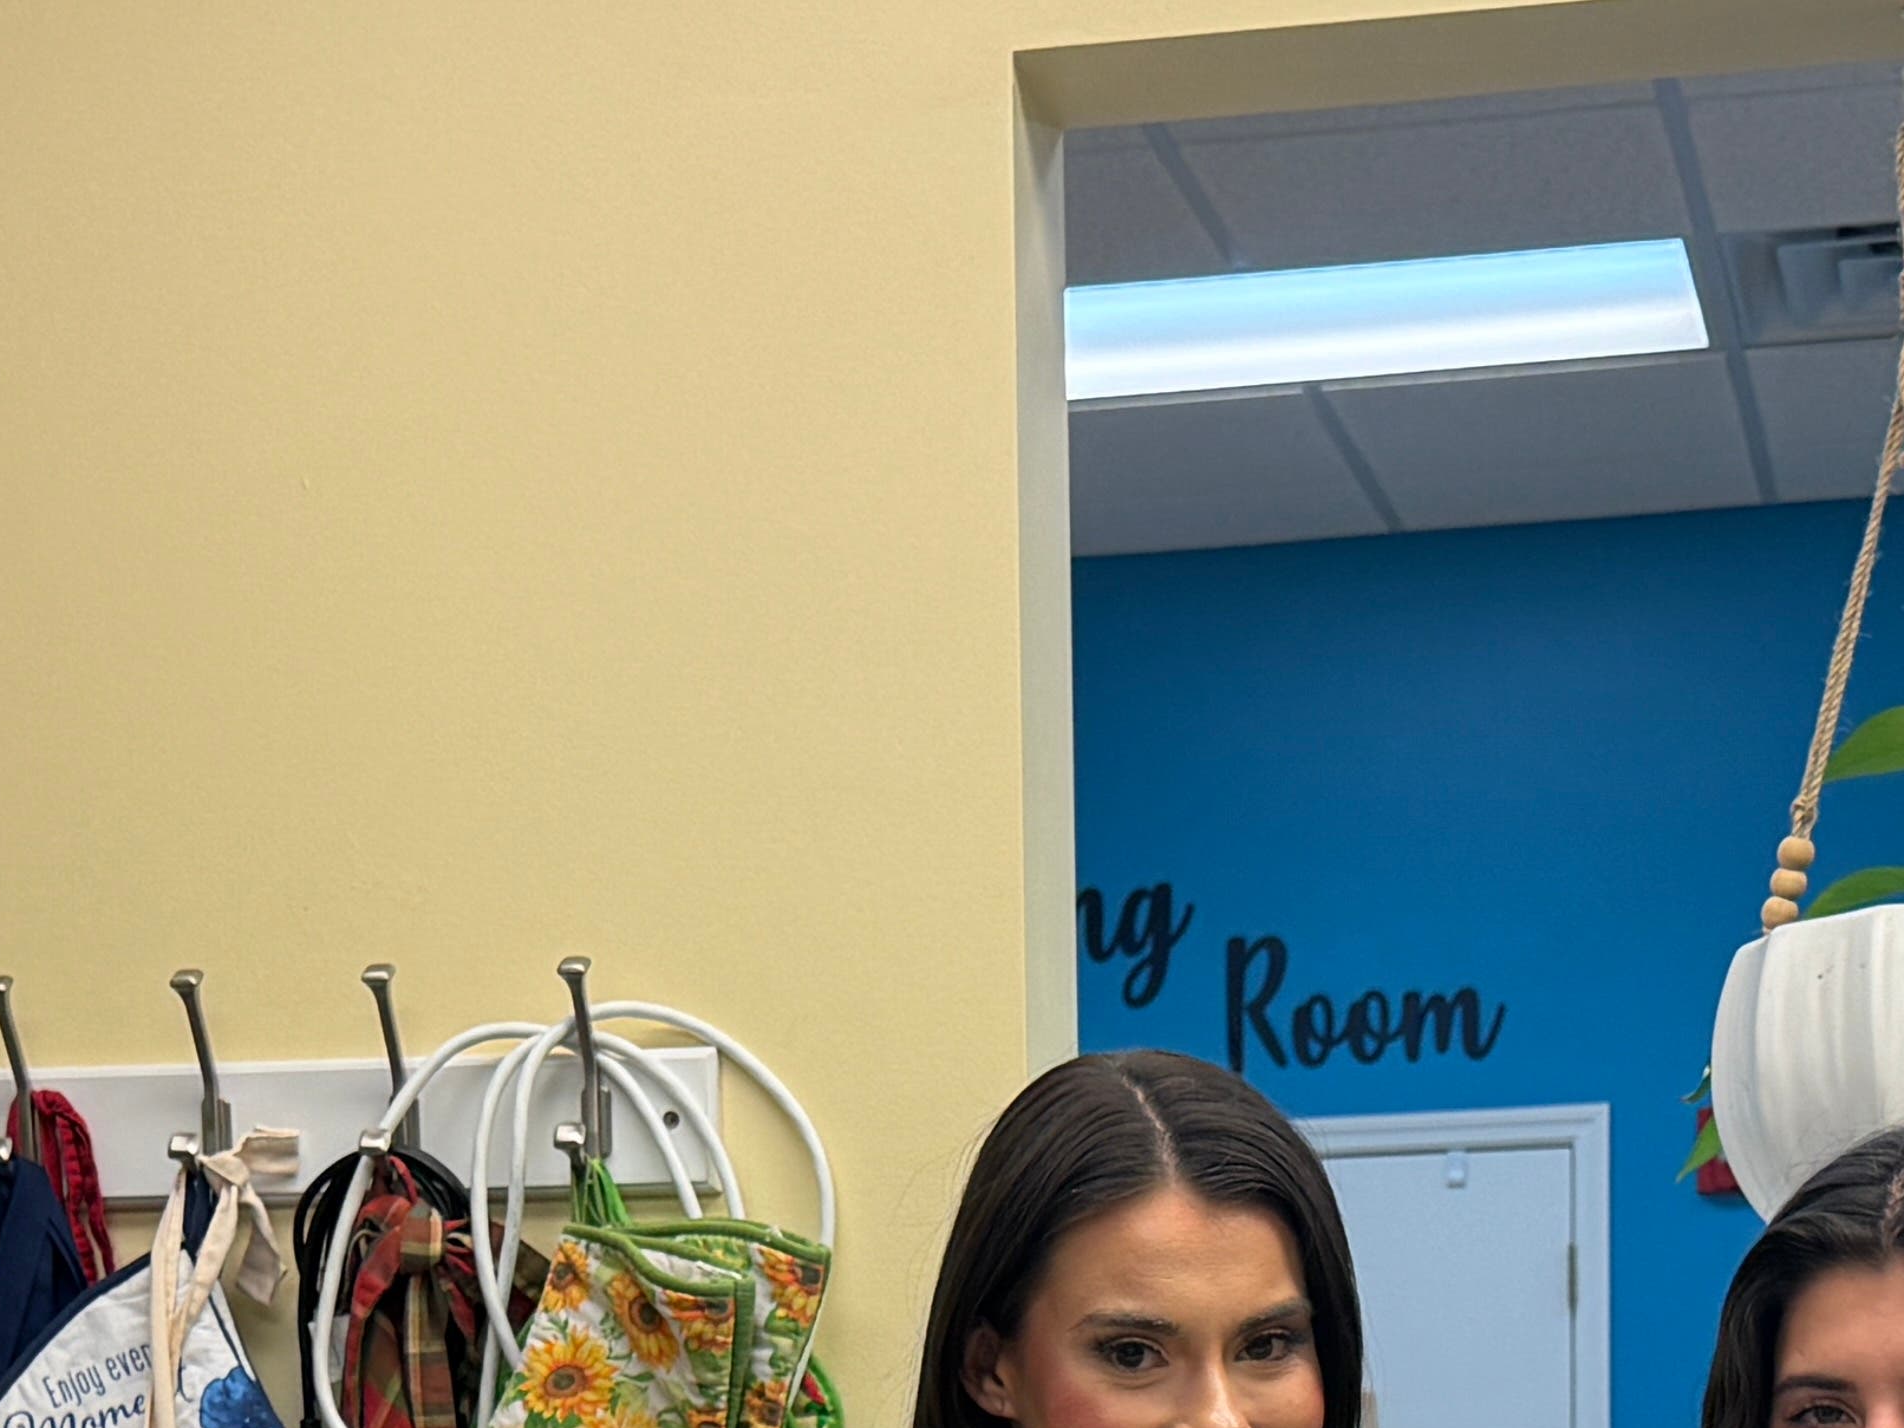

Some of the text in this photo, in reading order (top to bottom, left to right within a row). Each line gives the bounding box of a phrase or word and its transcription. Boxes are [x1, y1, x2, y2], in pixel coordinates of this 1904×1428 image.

[1225, 935, 1506, 1074] Room
[42, 1344, 152, 1409] Enjoy ever
